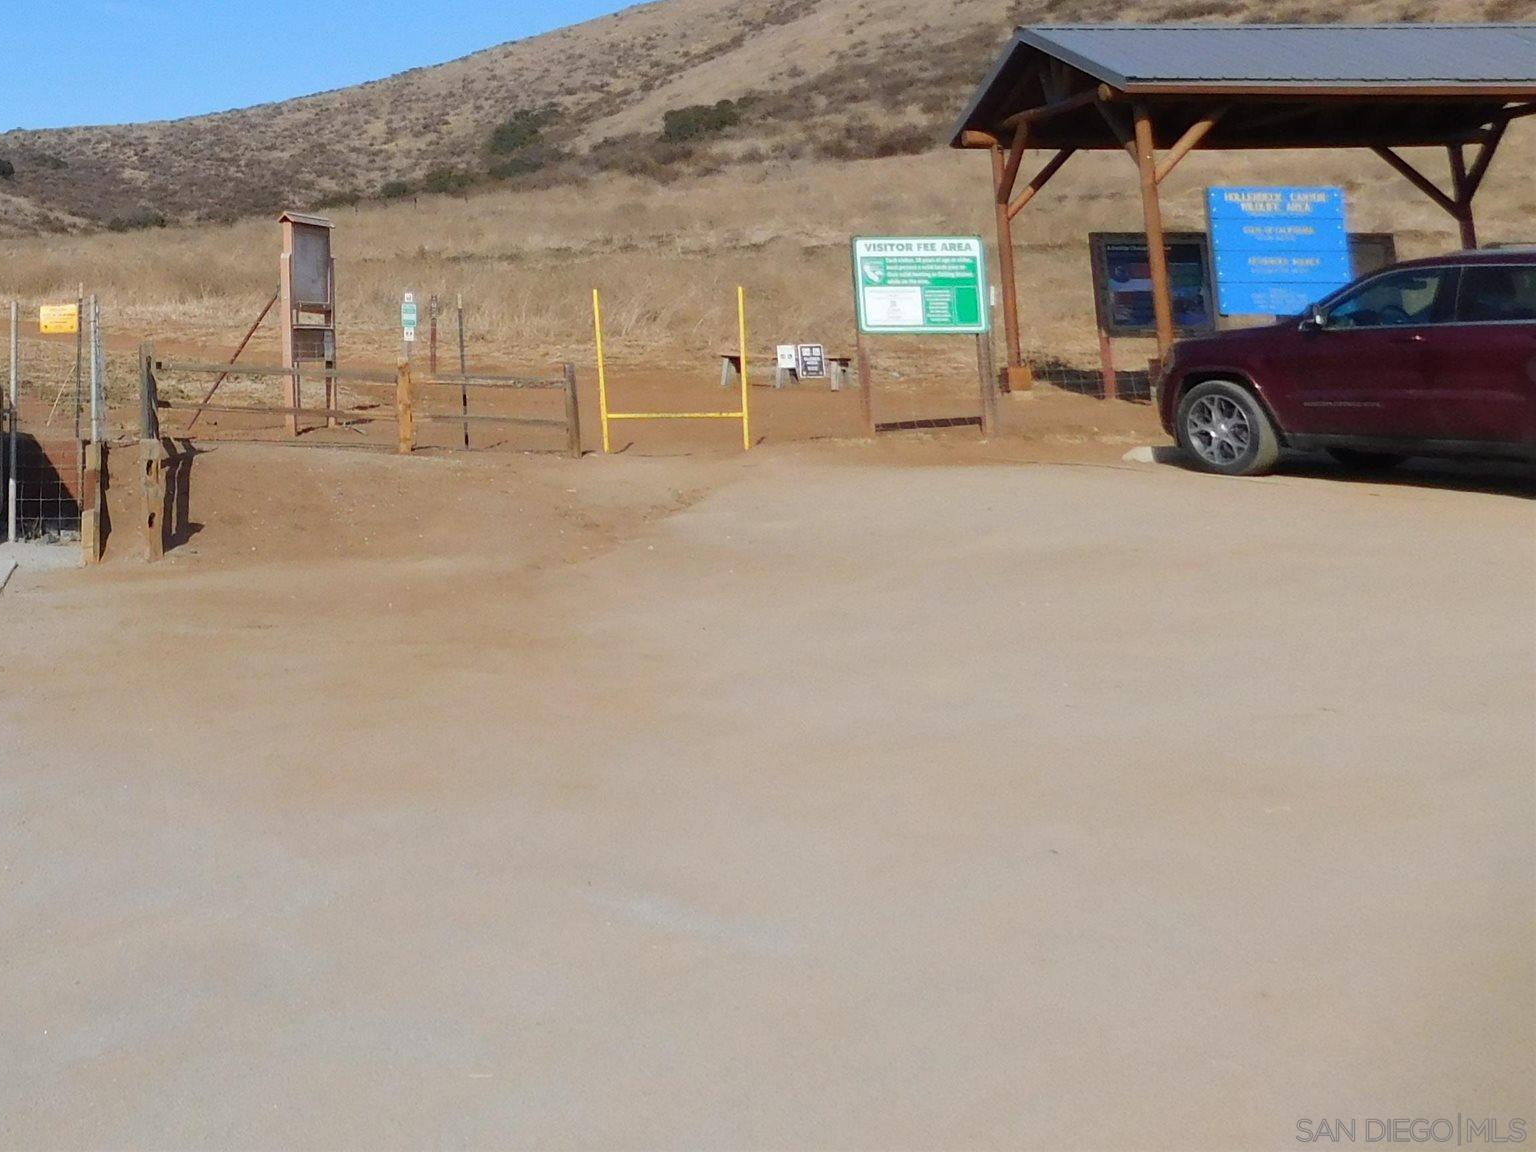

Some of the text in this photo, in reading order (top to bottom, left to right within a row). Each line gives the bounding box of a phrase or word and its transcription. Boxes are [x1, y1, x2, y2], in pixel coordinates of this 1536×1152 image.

[864, 242, 973, 252] VISITOR FEE AREA
